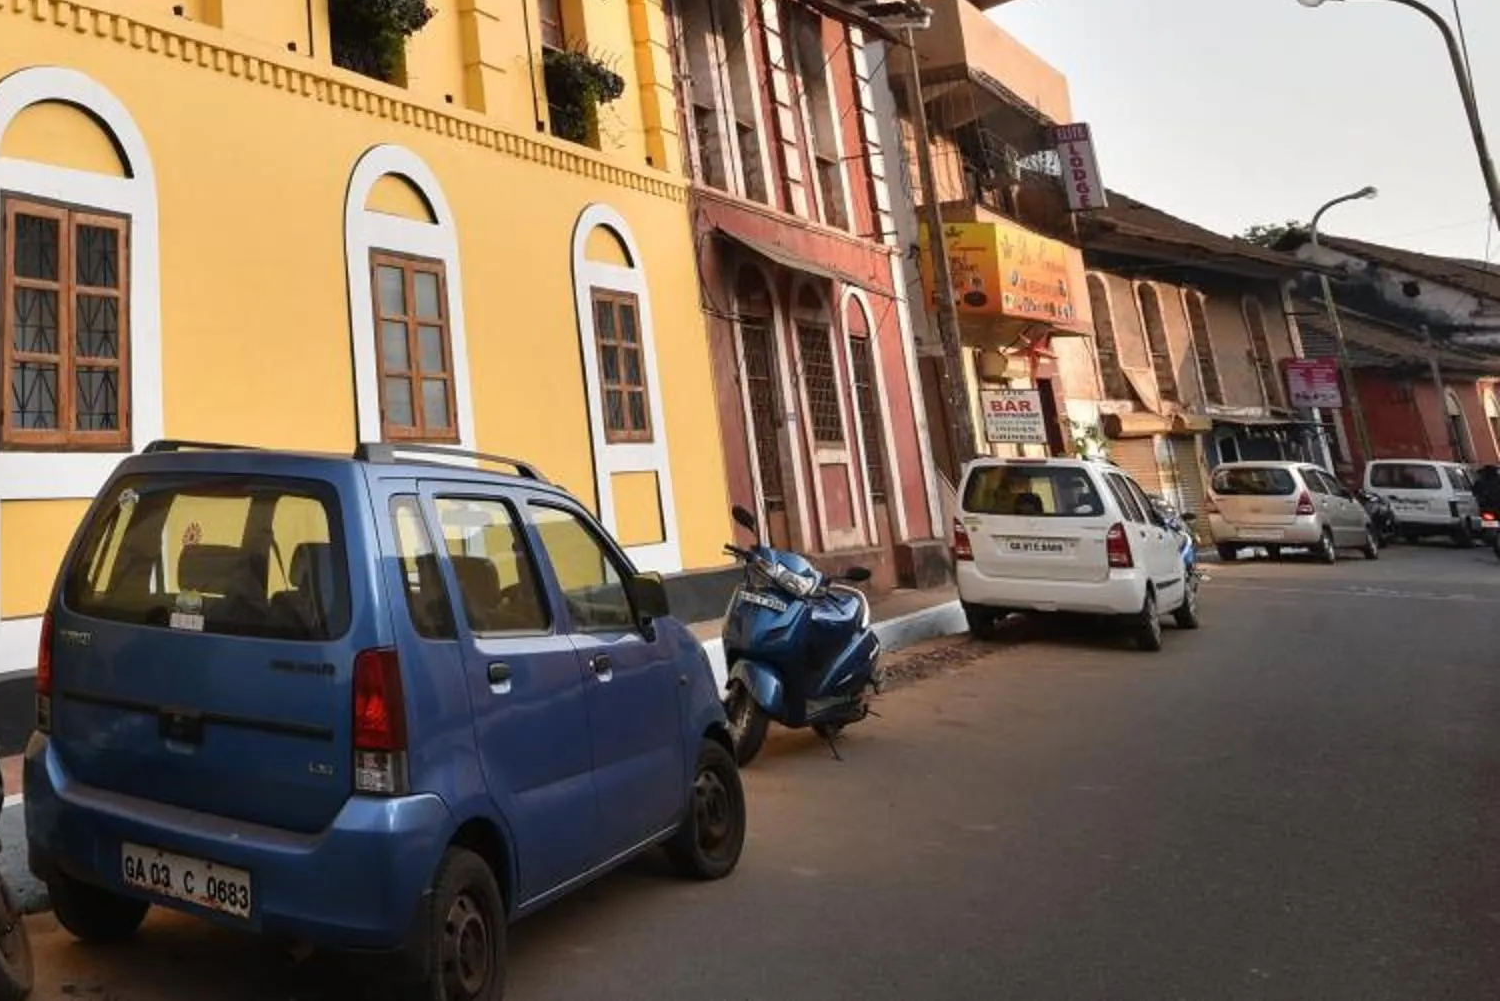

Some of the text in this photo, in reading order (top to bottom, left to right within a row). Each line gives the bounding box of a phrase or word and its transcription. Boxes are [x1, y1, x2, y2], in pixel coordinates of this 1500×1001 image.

[1068, 143, 1090, 208] LODGE
[990, 400, 1032, 412] BAR
[125, 856, 249, 909] GA 03 C 0683
